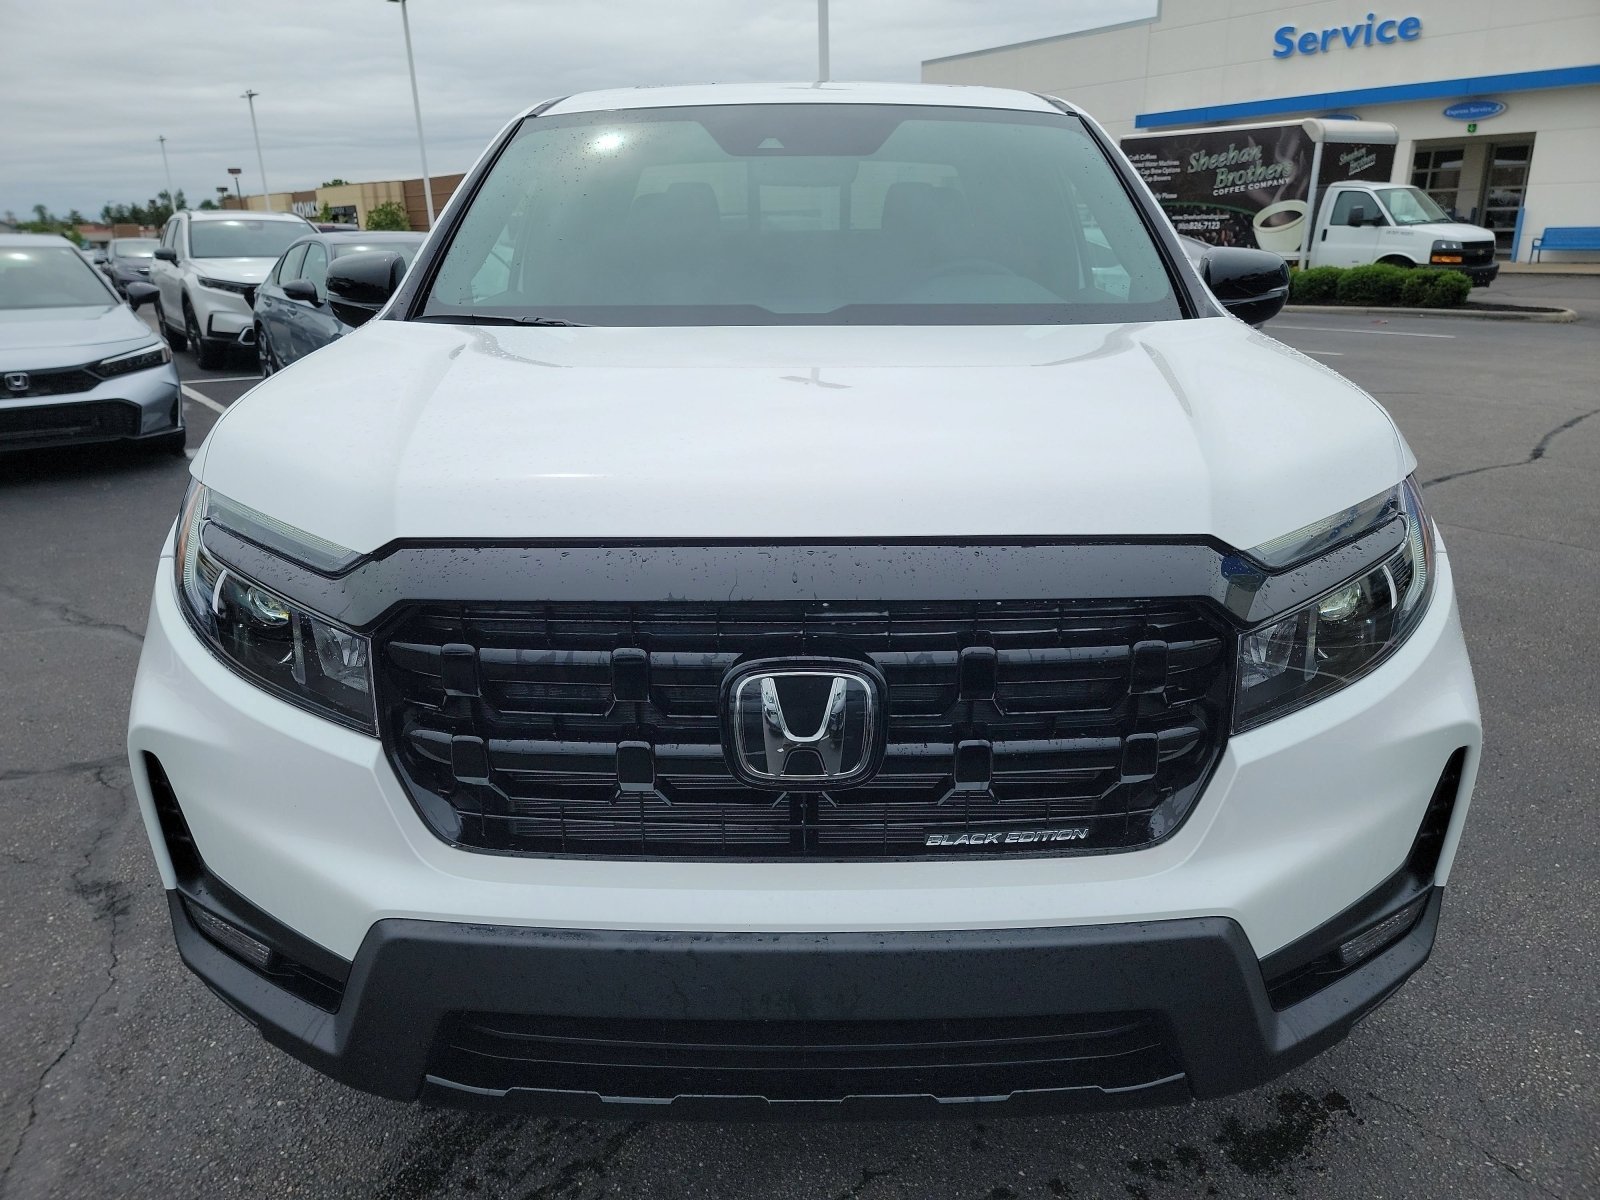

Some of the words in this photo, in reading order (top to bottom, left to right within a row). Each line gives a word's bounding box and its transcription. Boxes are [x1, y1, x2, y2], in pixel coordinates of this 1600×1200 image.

[1273, 13, 1421, 58] Service
[1187, 143, 1263, 174] Sheehan
[1213, 160, 1294, 189] Brothers
[1213, 185, 1246, 196] COFFEE
[1247, 177, 1290, 191] COMPANY
[926, 833, 1001, 846] BLACK
[1004, 828, 1089, 843] EDITION
